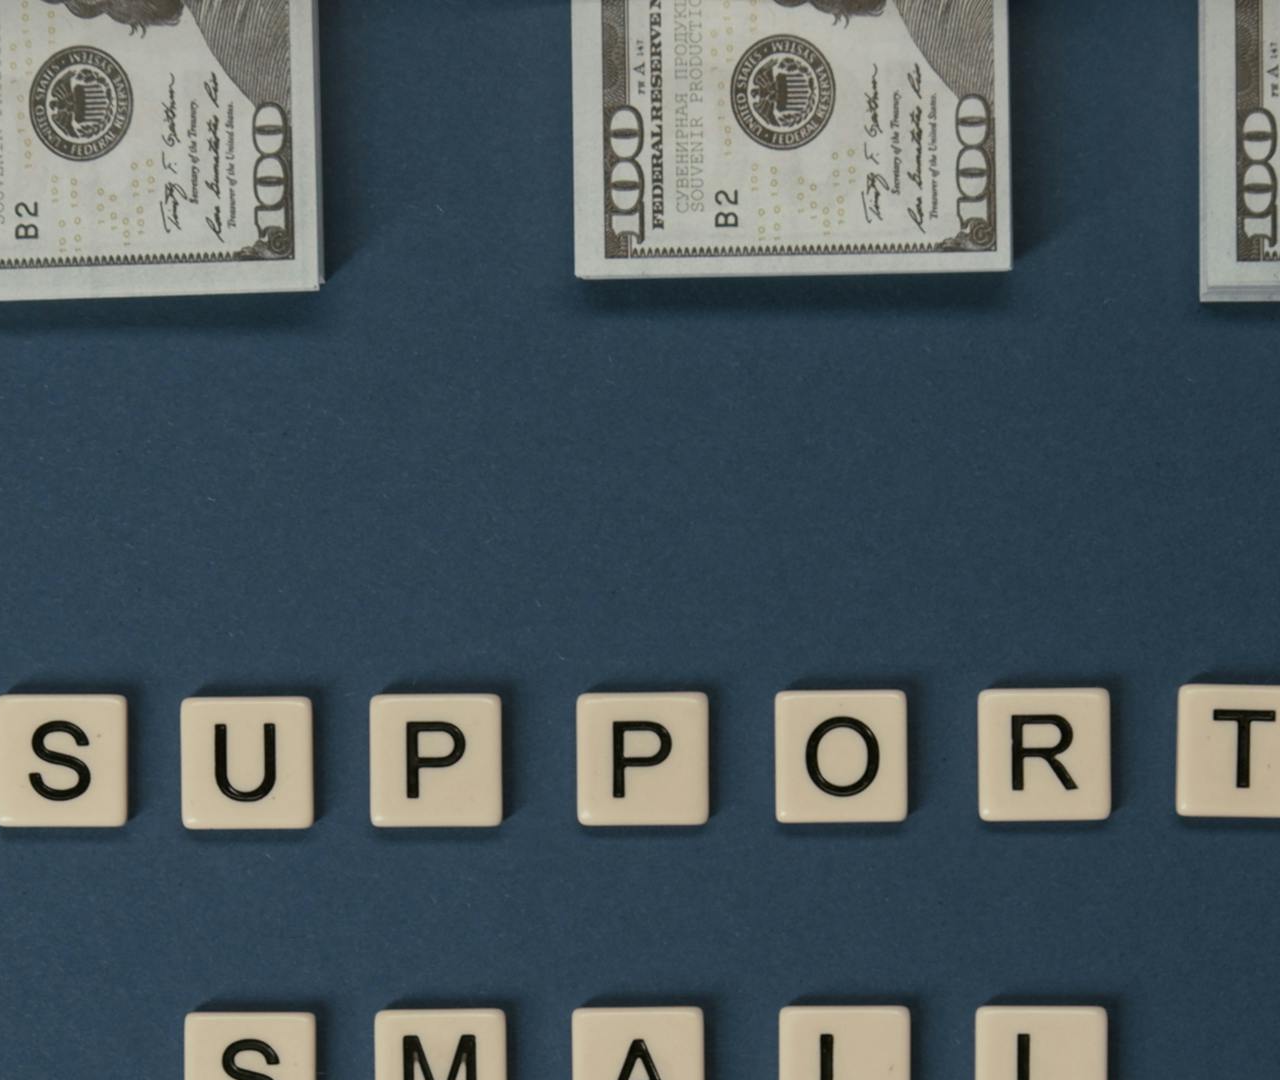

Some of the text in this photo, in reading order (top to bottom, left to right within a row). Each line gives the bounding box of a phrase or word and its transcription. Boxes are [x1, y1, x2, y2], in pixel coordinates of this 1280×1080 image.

[251, 102, 289, 238] 100
[608, 104, 645, 245] 100
[648, 13, 664, 230] FEDERAL RESERVE
[955, 93, 991, 230] 100
[1241, 106, 1278, 248] 100
[29, 709, 1275, 802] SUPPORT
